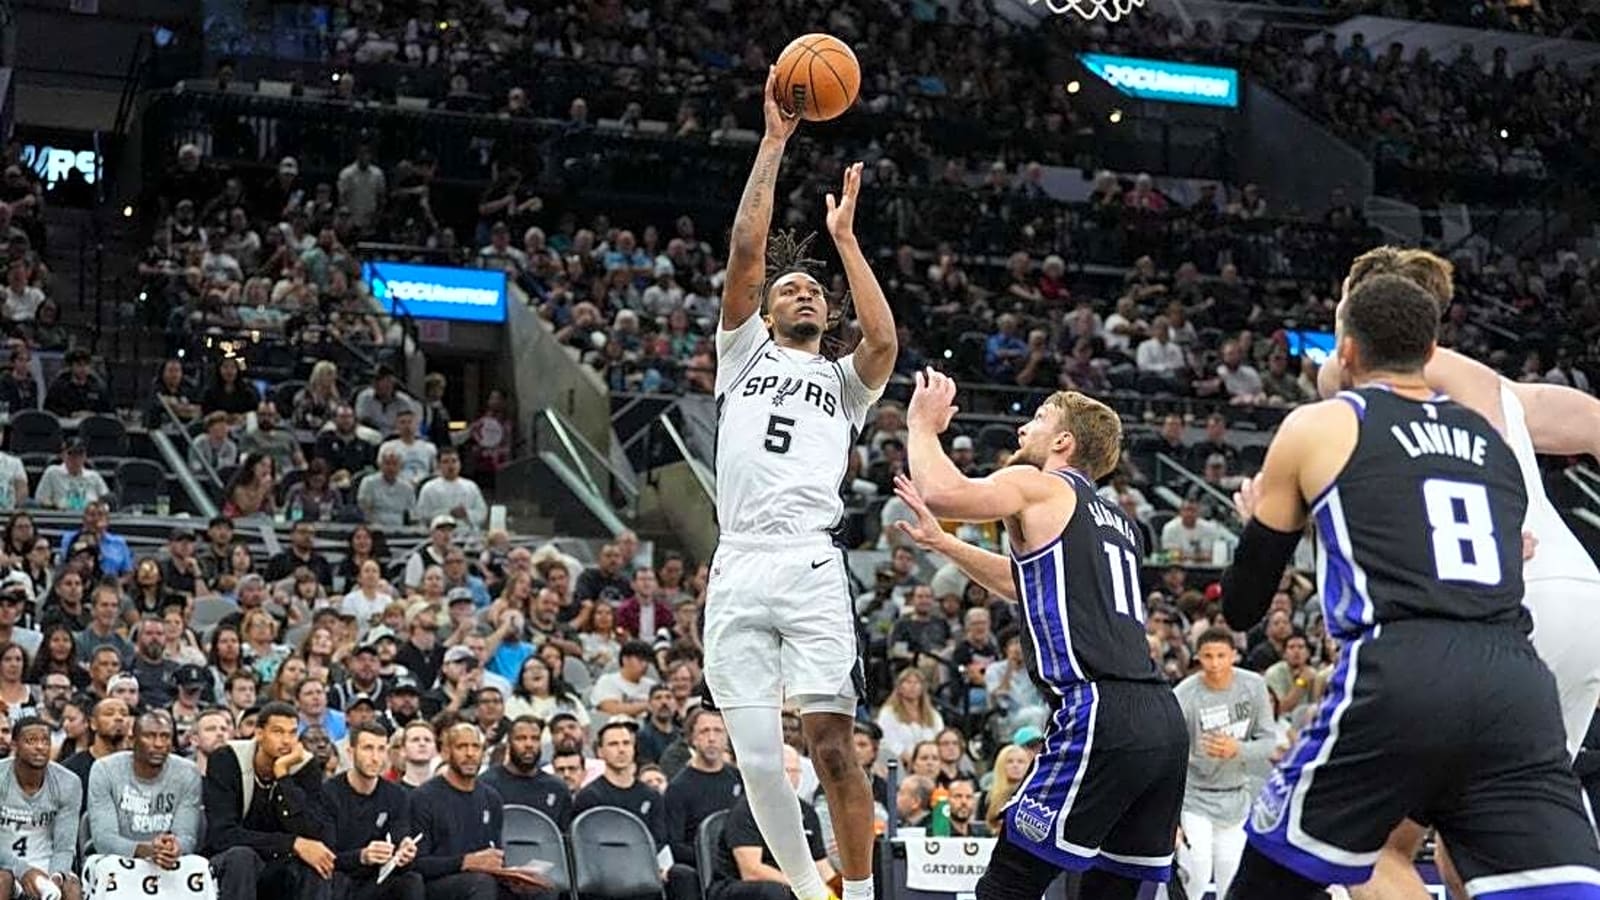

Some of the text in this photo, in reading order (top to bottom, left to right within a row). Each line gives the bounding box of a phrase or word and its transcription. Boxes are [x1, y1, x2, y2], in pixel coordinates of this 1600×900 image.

[742, 375, 838, 417] SPURS
[764, 415, 796, 454] 5
[1391, 421, 1488, 467] LAVINE
[1423, 478, 1502, 586] 8
[1103, 541, 1145, 624] 11
[12, 836, 28, 857] 4
[142, 872, 204, 895] G G
[922, 863, 987, 875] GATORAD
